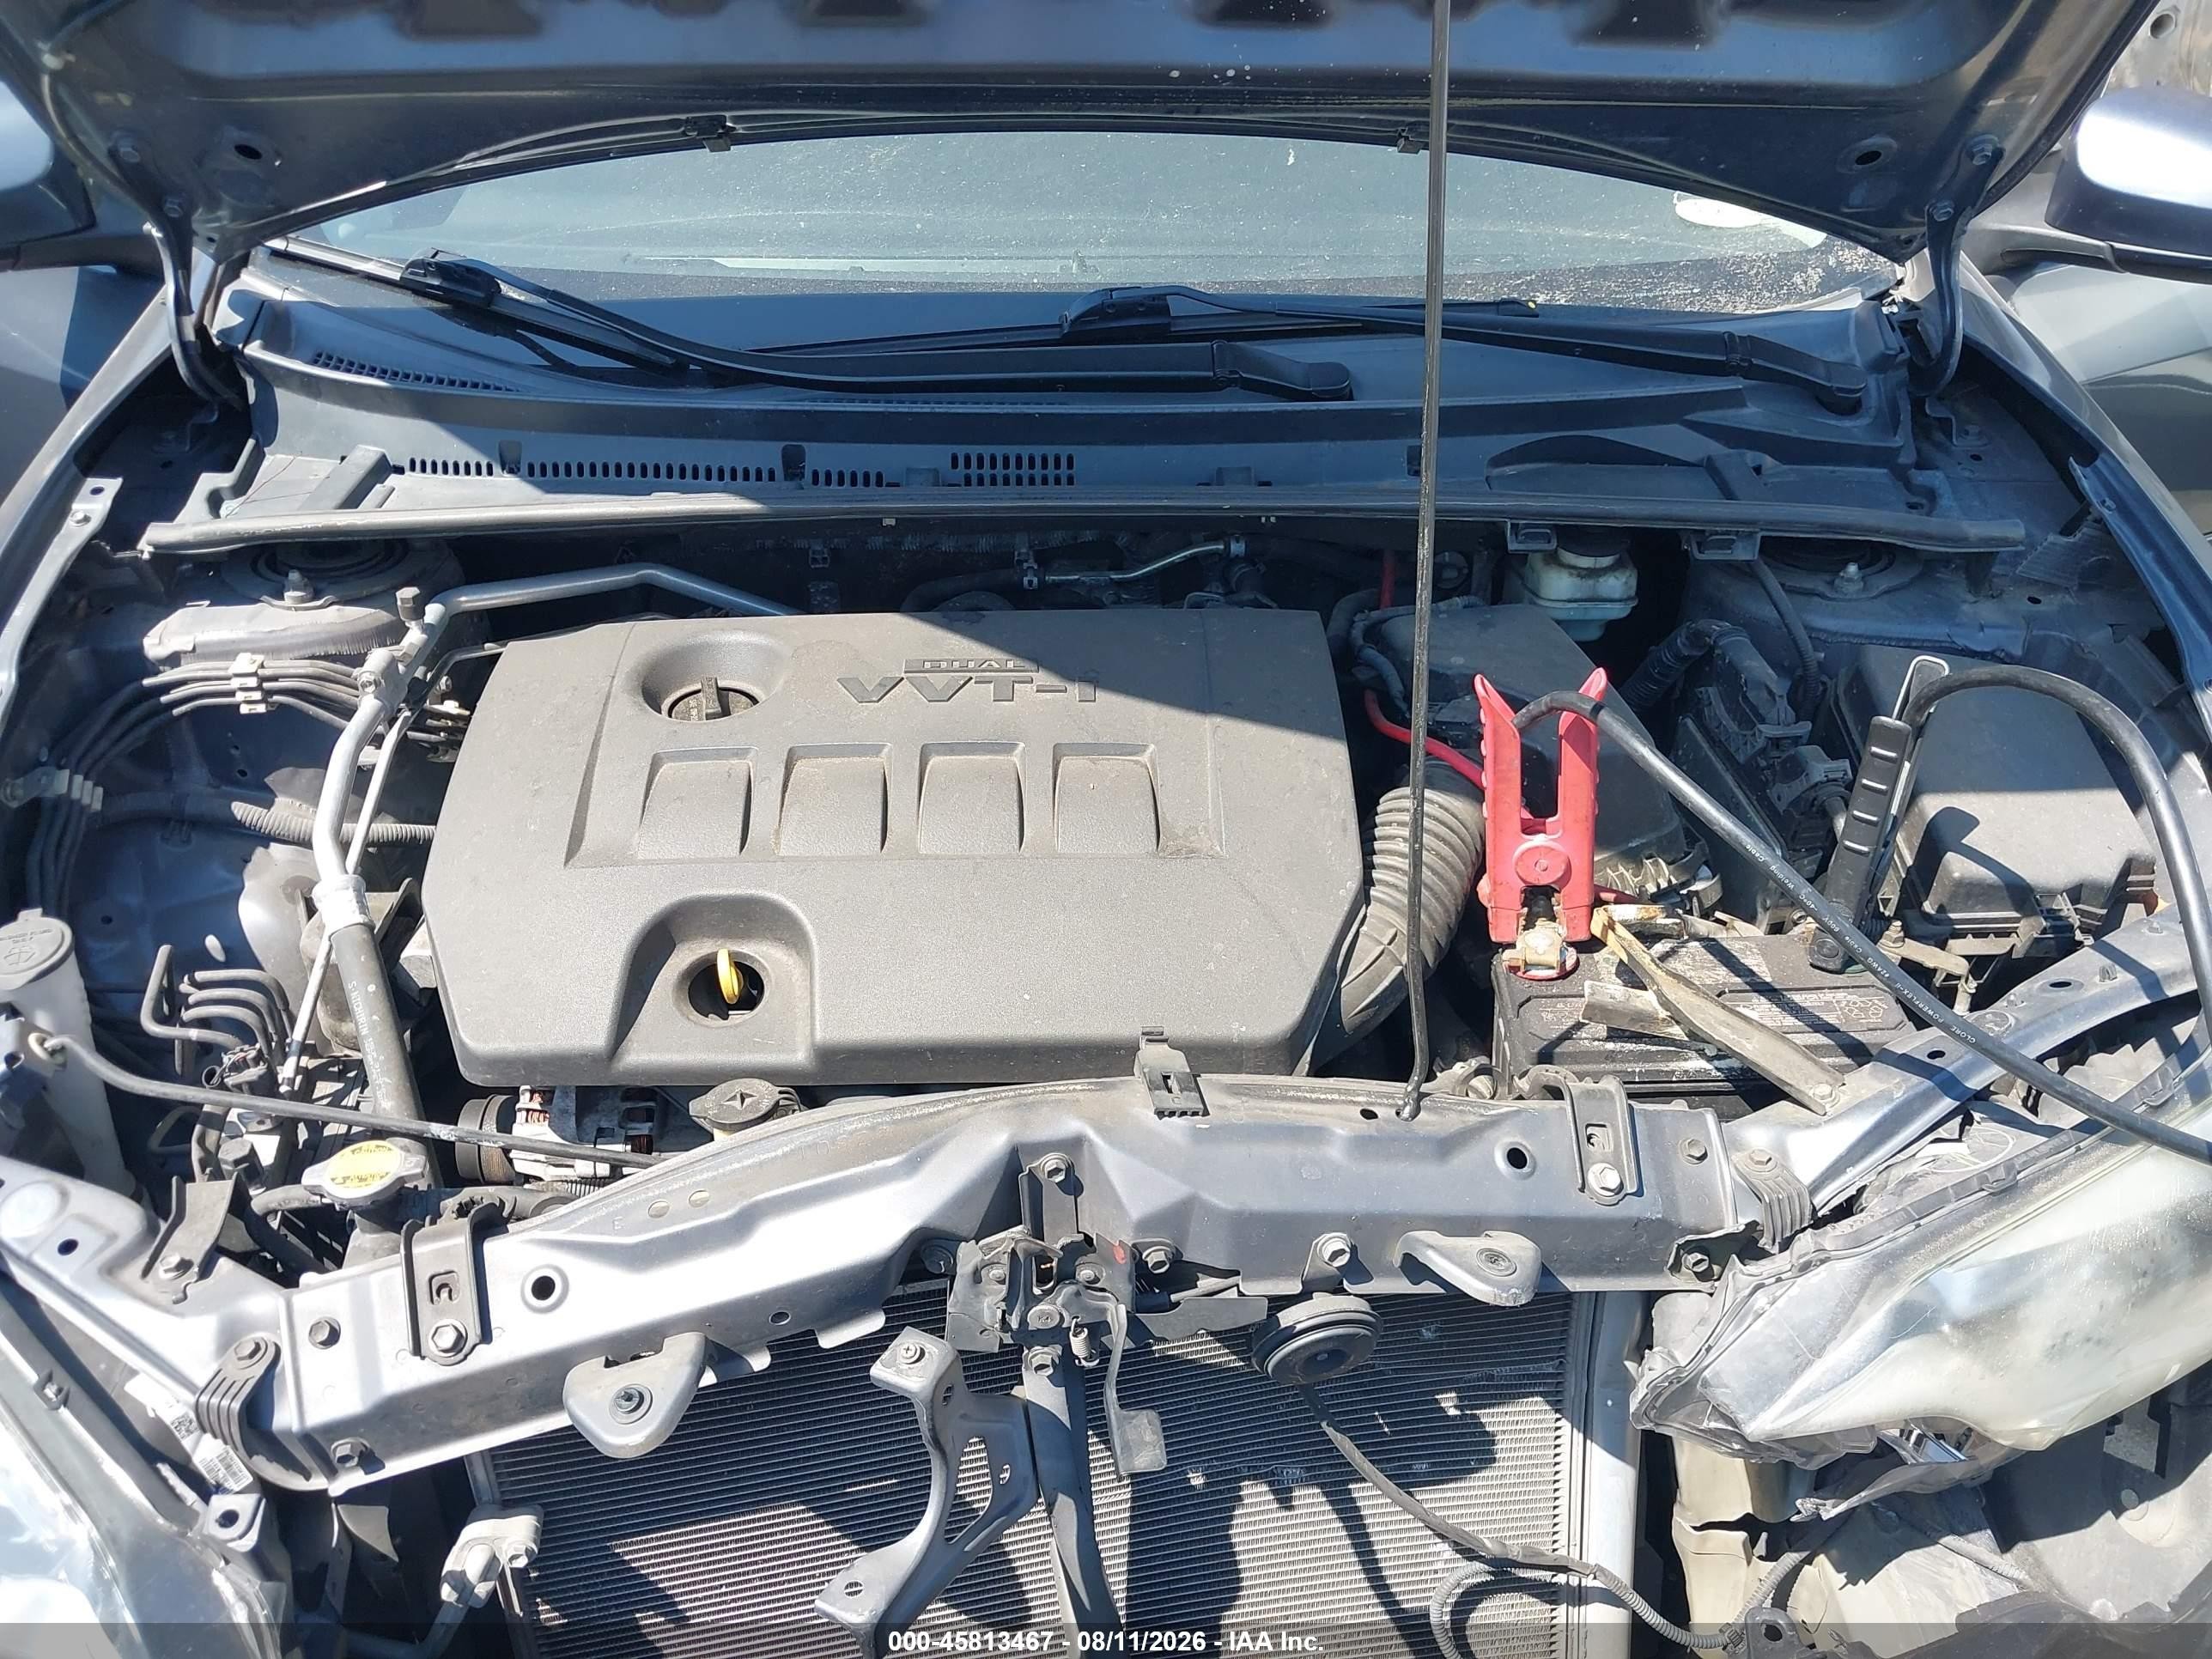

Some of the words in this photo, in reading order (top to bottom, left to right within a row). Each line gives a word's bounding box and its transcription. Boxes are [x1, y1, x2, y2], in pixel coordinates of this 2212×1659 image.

[921, 659, 1025, 669] DUAL
[1745, 843, 1765, 862] Cable
[1769, 864, 1795, 890] Welding
[1844, 936, 1863, 953] Cable
[1950, 1025, 1976, 1043] CLORE
